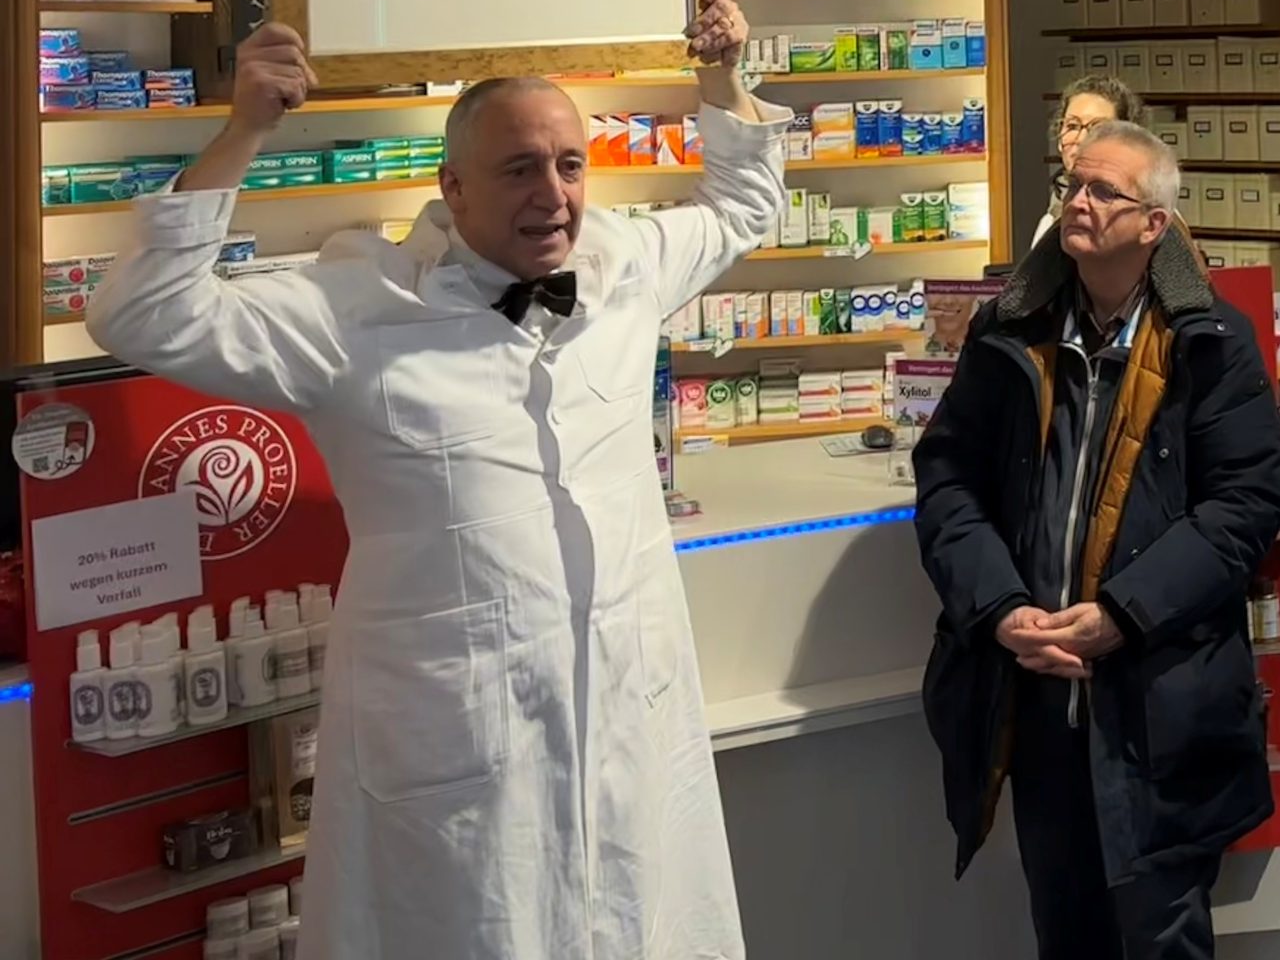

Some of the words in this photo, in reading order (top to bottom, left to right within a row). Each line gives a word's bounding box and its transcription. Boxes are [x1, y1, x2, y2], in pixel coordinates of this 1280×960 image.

[342, 153, 373, 163] ASPIRIN
[899, 385, 931, 399] Xylitol
[149, 414, 228, 491] ANNES
[233, 416, 287, 542] PROELLER
[78, 553, 107, 566] 20%
[109, 540, 156, 559] Rabatt
[69, 573, 114, 591] wegen
[116, 562, 169, 580] kurzem
[96, 586, 142, 605] Verfall
